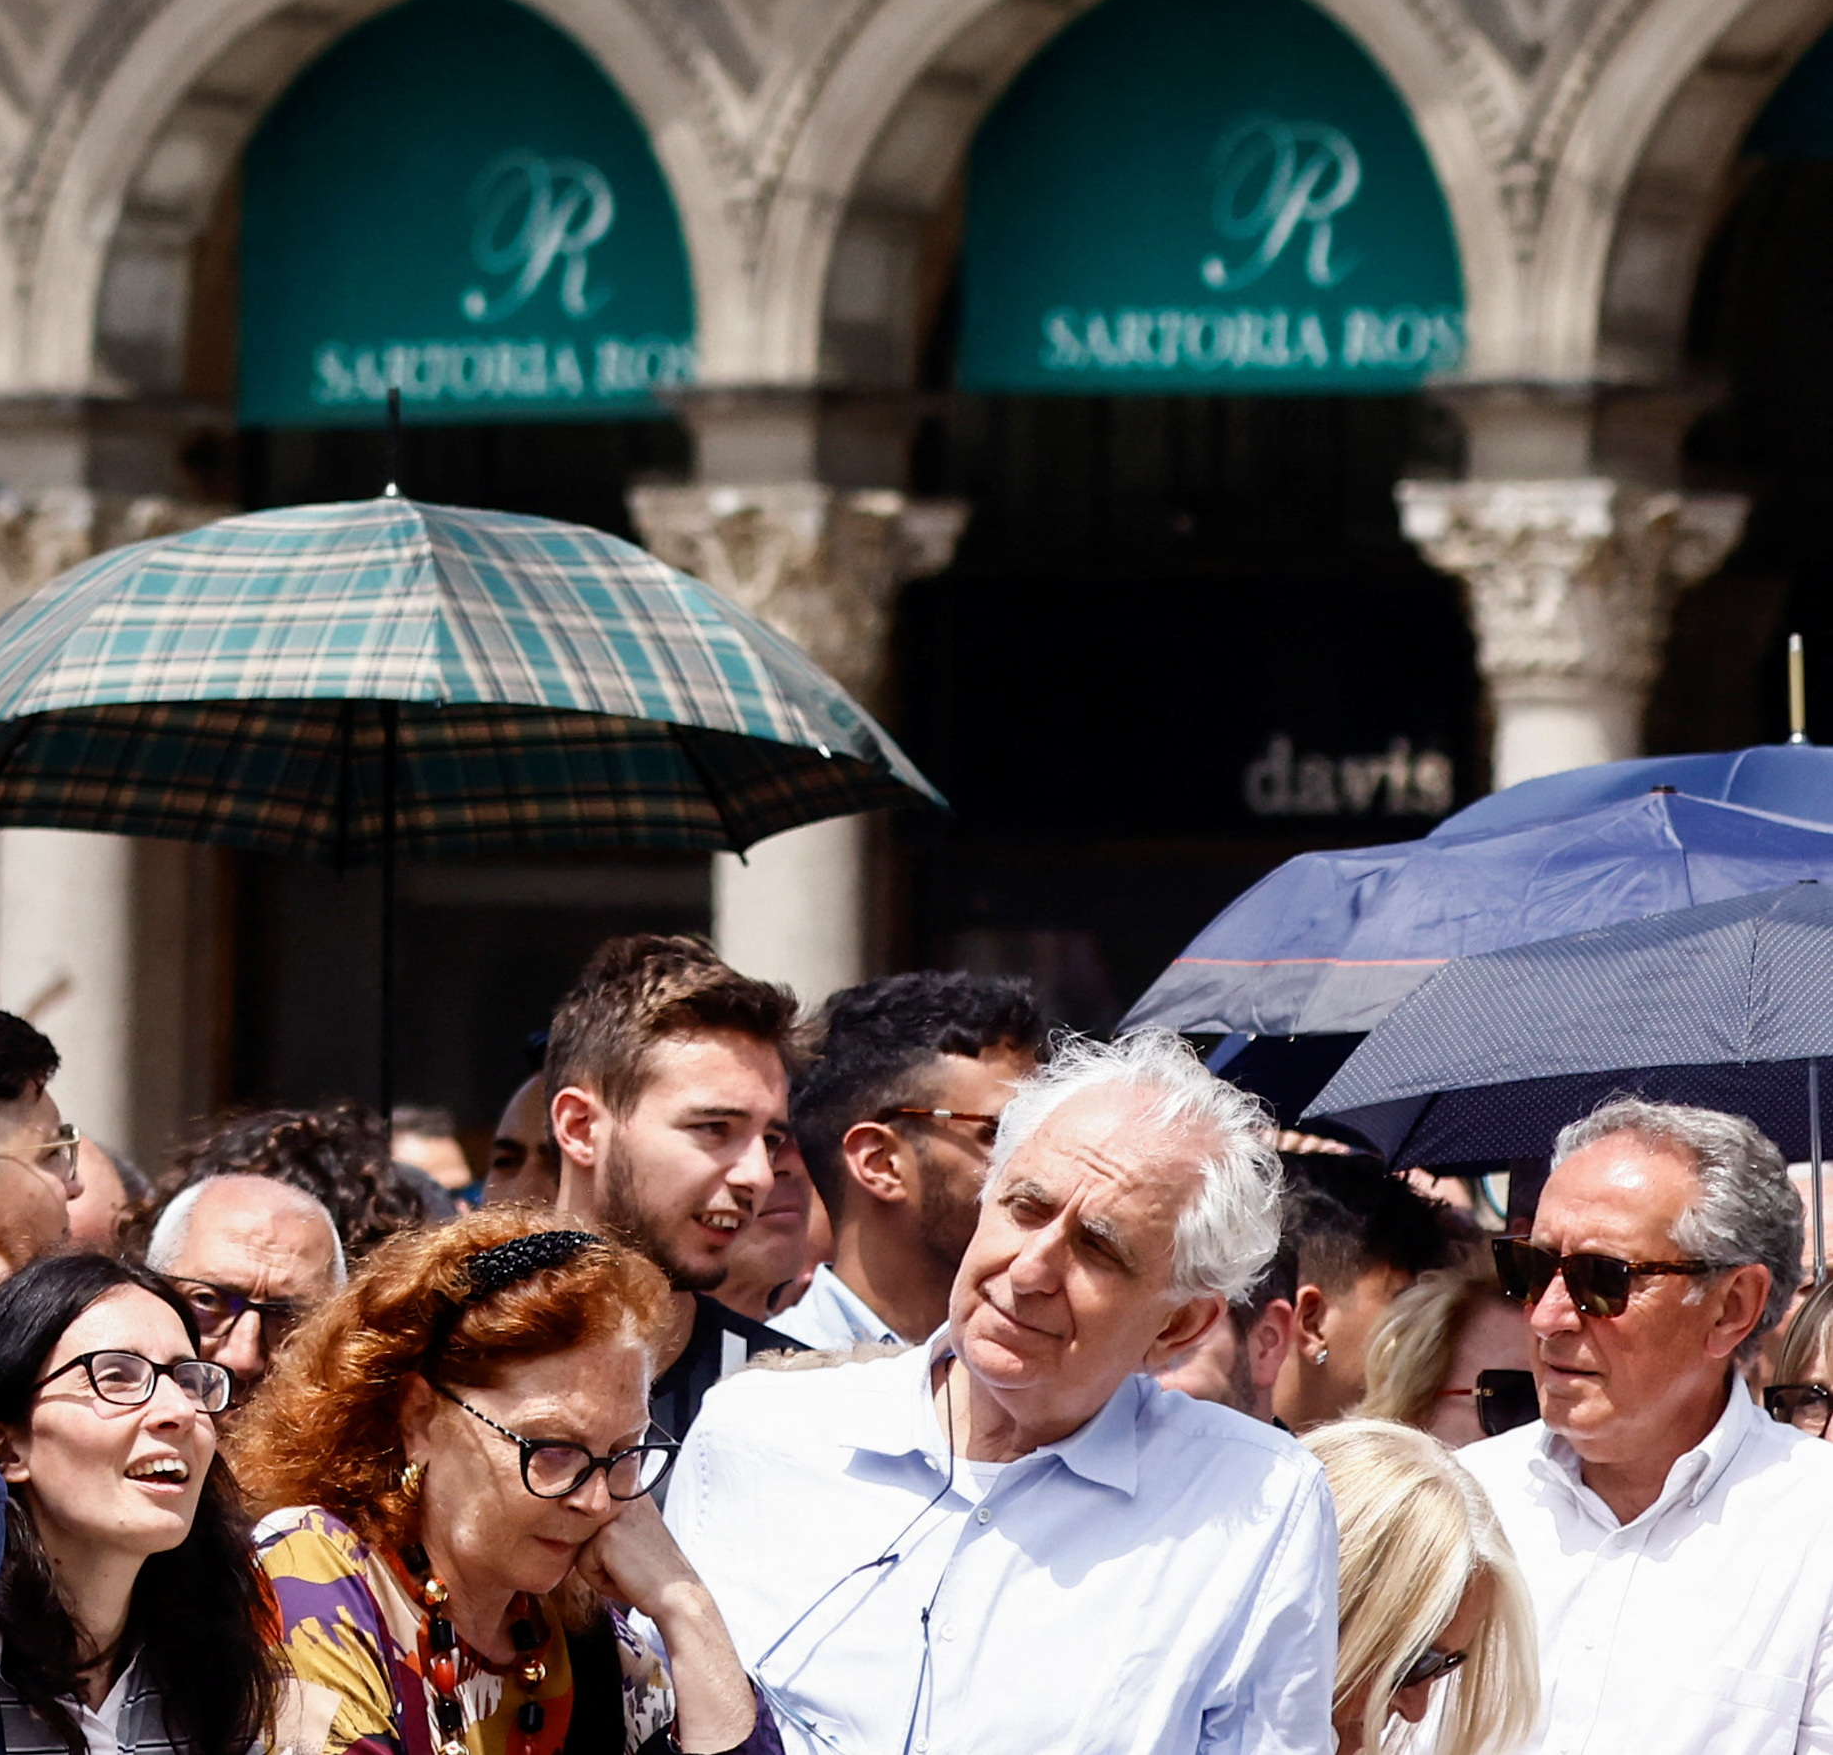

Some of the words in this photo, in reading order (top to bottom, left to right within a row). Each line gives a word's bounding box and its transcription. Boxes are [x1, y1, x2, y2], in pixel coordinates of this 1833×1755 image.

[1039, 307, 1330, 370] SARTORIA
[312, 341, 583, 405] SARTORIA
[1243, 734, 1455, 816] davis
